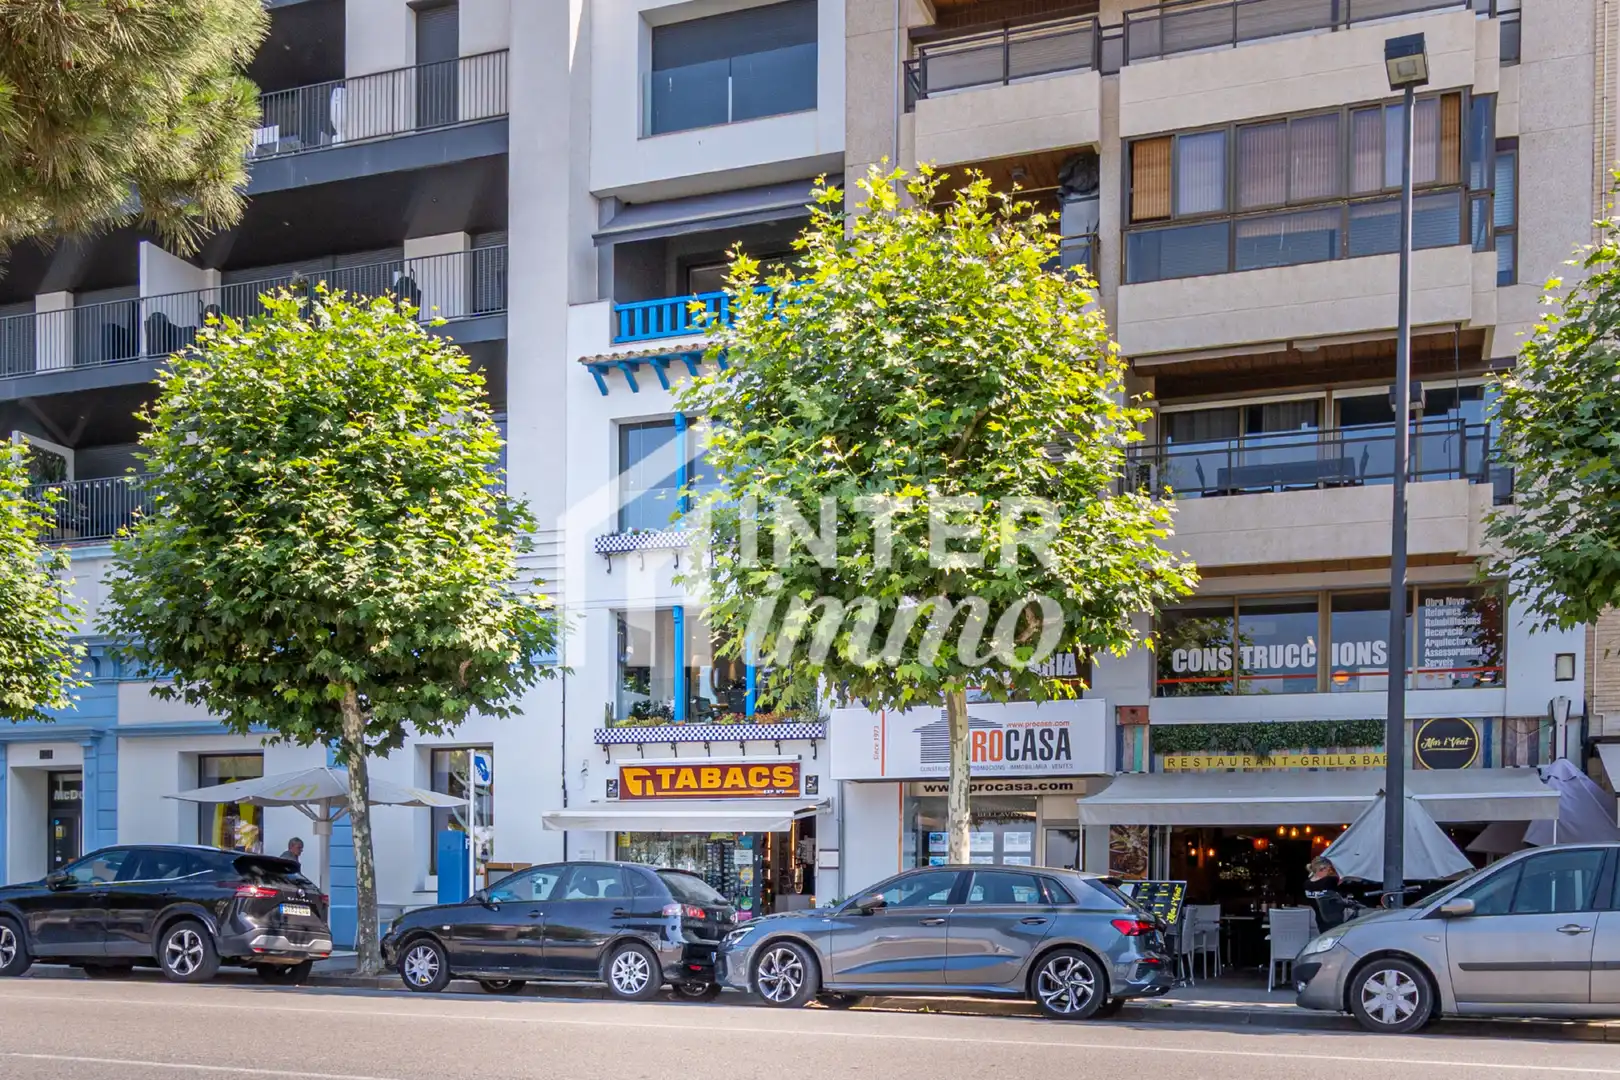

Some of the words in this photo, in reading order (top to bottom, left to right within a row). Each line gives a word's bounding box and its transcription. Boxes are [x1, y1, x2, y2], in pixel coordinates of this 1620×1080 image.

[1425, 598, 1444, 607] Obra
[1446, 597, 1465, 605] Nova
[1425, 638, 1472, 648] Arquitectura
[1425, 658, 1454, 668] Serveis
[971, 728, 1072, 762] ROCASA
[656, 766, 794, 789] TABACS
